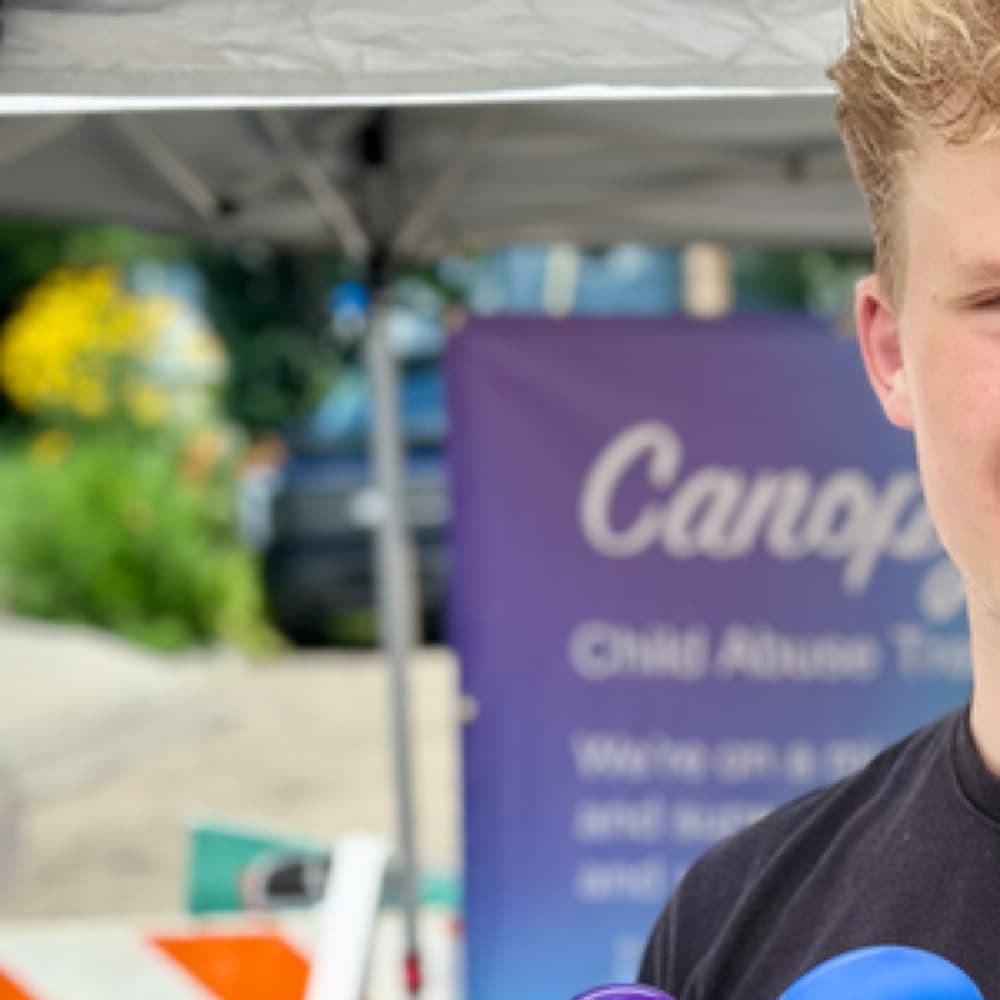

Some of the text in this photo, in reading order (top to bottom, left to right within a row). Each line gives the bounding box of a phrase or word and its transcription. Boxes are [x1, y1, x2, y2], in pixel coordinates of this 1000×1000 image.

[579, 420, 966, 624] Canop
[571, 622, 708, 681] Child
[717, 625, 881, 681] Abuse
